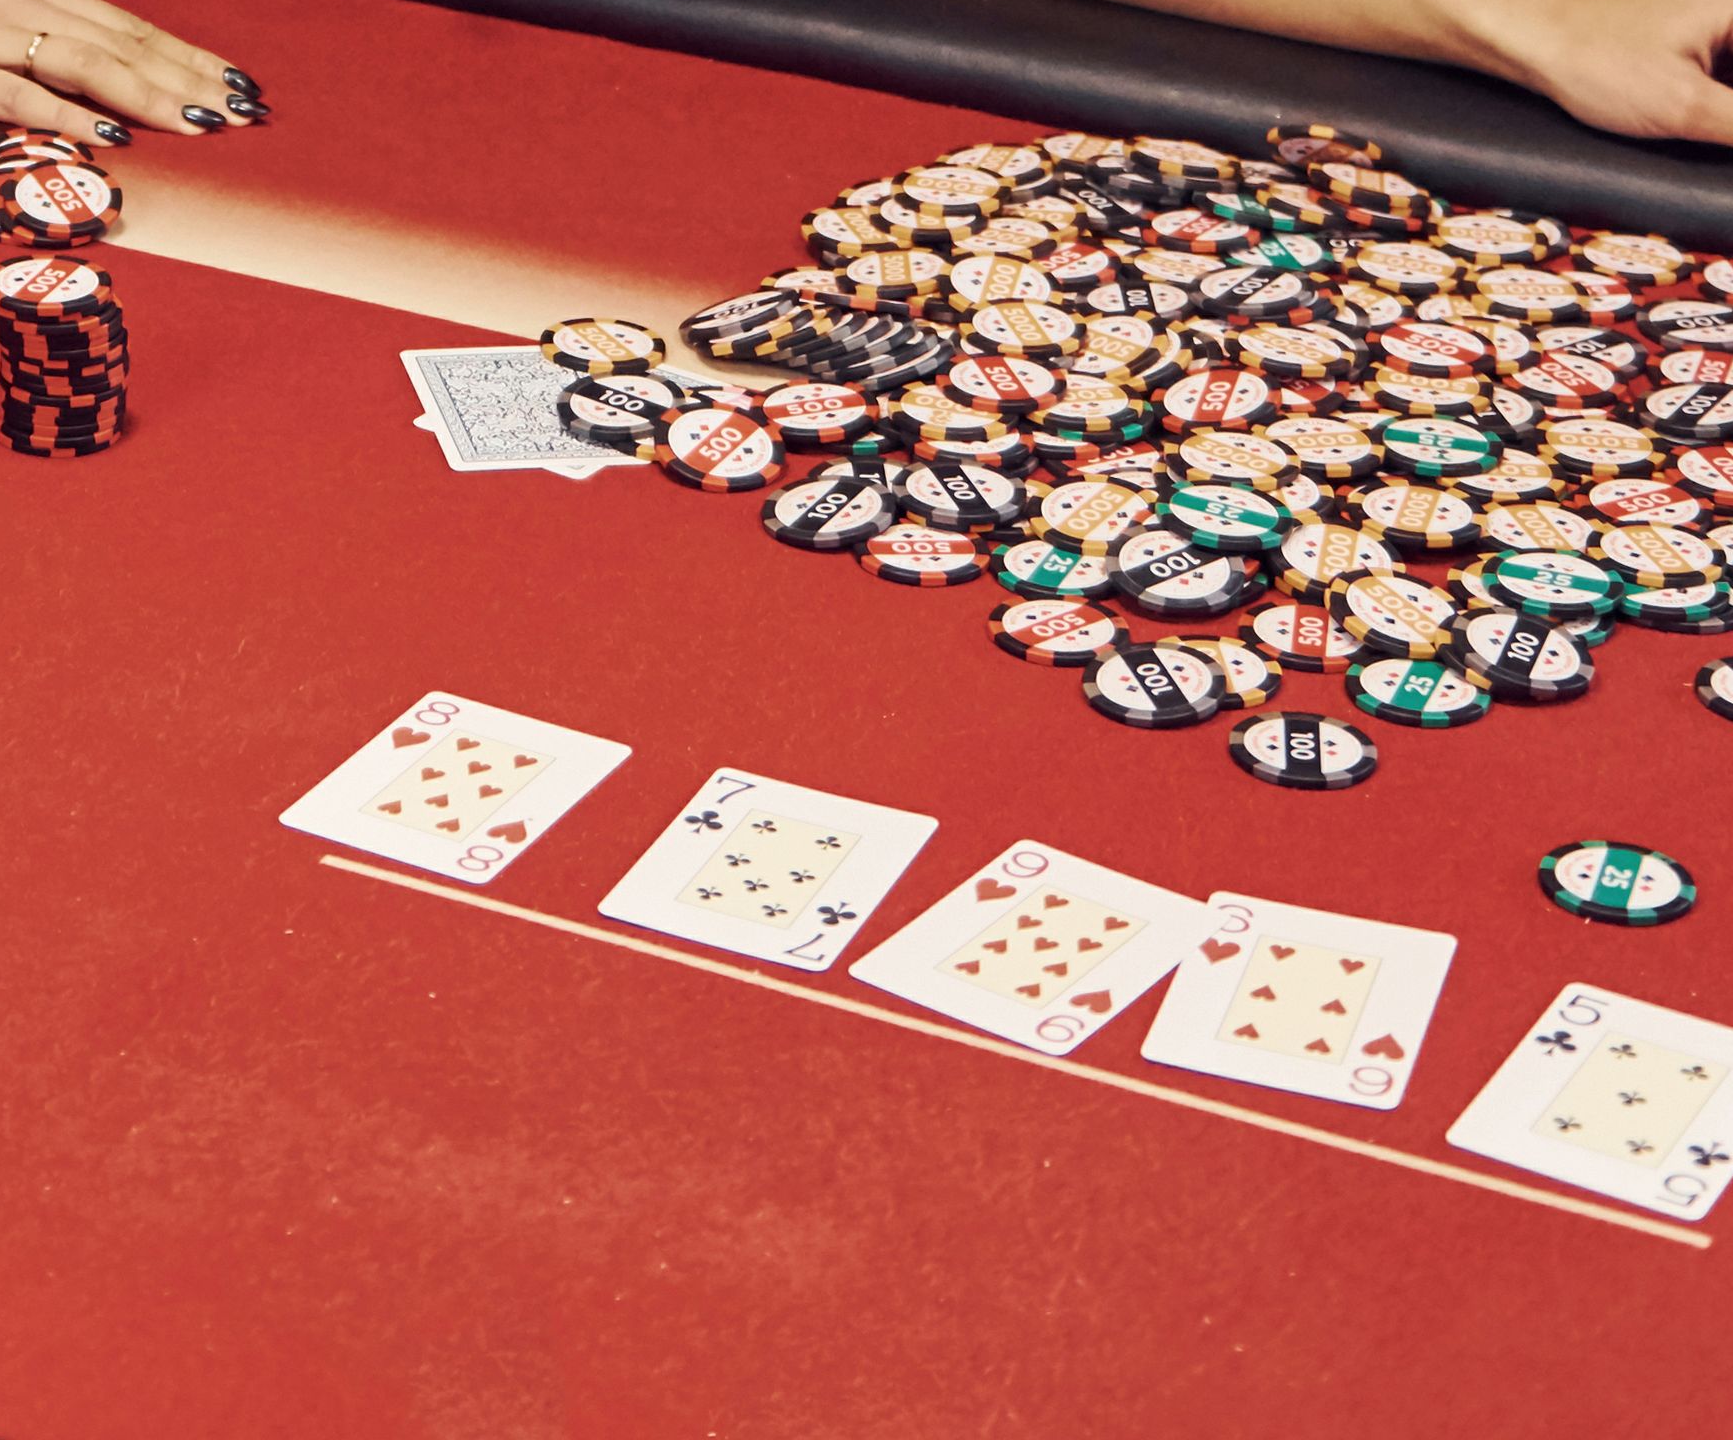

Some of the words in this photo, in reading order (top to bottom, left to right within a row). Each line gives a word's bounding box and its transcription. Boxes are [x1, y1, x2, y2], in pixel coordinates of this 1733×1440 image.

[44, 177, 83, 212] 500
[1078, 190, 1113, 209] 100
[983, 230, 1032, 244] 000
[27, 268, 67, 293] 500
[1232, 277, 1269, 296] 100
[1126, 290, 1148, 306] 100
[1003, 307, 1043, 341] 5000
[1676, 315, 1726, 329] 100
[578, 327, 627, 358] 5000
[1088, 335, 1133, 357] 500
[1258, 333, 1325, 359] 5000
[1403, 333, 1459, 355] 500
[984, 366, 1019, 391] 500
[1390, 372, 1468, 392] 5000
[1541, 362, 1585, 387] 500
[1698, 359, 1727, 382] 500
[598, 390, 645, 412] 100
[786, 398, 843, 414] 500
[1201, 381, 1232, 412] 500
[1682, 394, 1718, 415] 100
[698, 426, 743, 463] 500
[1418, 434, 1453, 448] 25
[1559, 435, 1639, 448] 5000
[1196, 440, 1269, 470] 5000
[943, 475, 976, 500] 100
[808, 493, 848, 520] 100
[1068, 490, 1125, 530] 5000
[1204, 502, 1246, 519] 25
[1400, 492, 1433, 527] 5000
[1617, 493, 1671, 513] 500
[892, 541, 951, 553] 500
[1631, 530, 1685, 568] 5000
[1043, 554, 1074, 573] 25
[1149, 551, 1201, 578] 100
[1532, 570, 1573, 587] 25
[1366, 586, 1435, 636] 5000
[1031, 613, 1087, 637] 500
[1298, 616, 1324, 647] 500
[1507, 632, 1541, 663] 100
[1136, 663, 1174, 697] 100
[1405, 675, 1434, 697] 25
[415, 700, 461, 727] 8
[1290, 732, 1316, 761] 100
[715, 776, 758, 805] 7
[456, 845, 504, 872] 8
[1001, 851, 1050, 878] 9
[1600, 865, 1633, 891] 25
[784, 933, 826, 962] 7
[1558, 994, 1610, 1027] 5
[1656, 1173, 1708, 1207] 5
